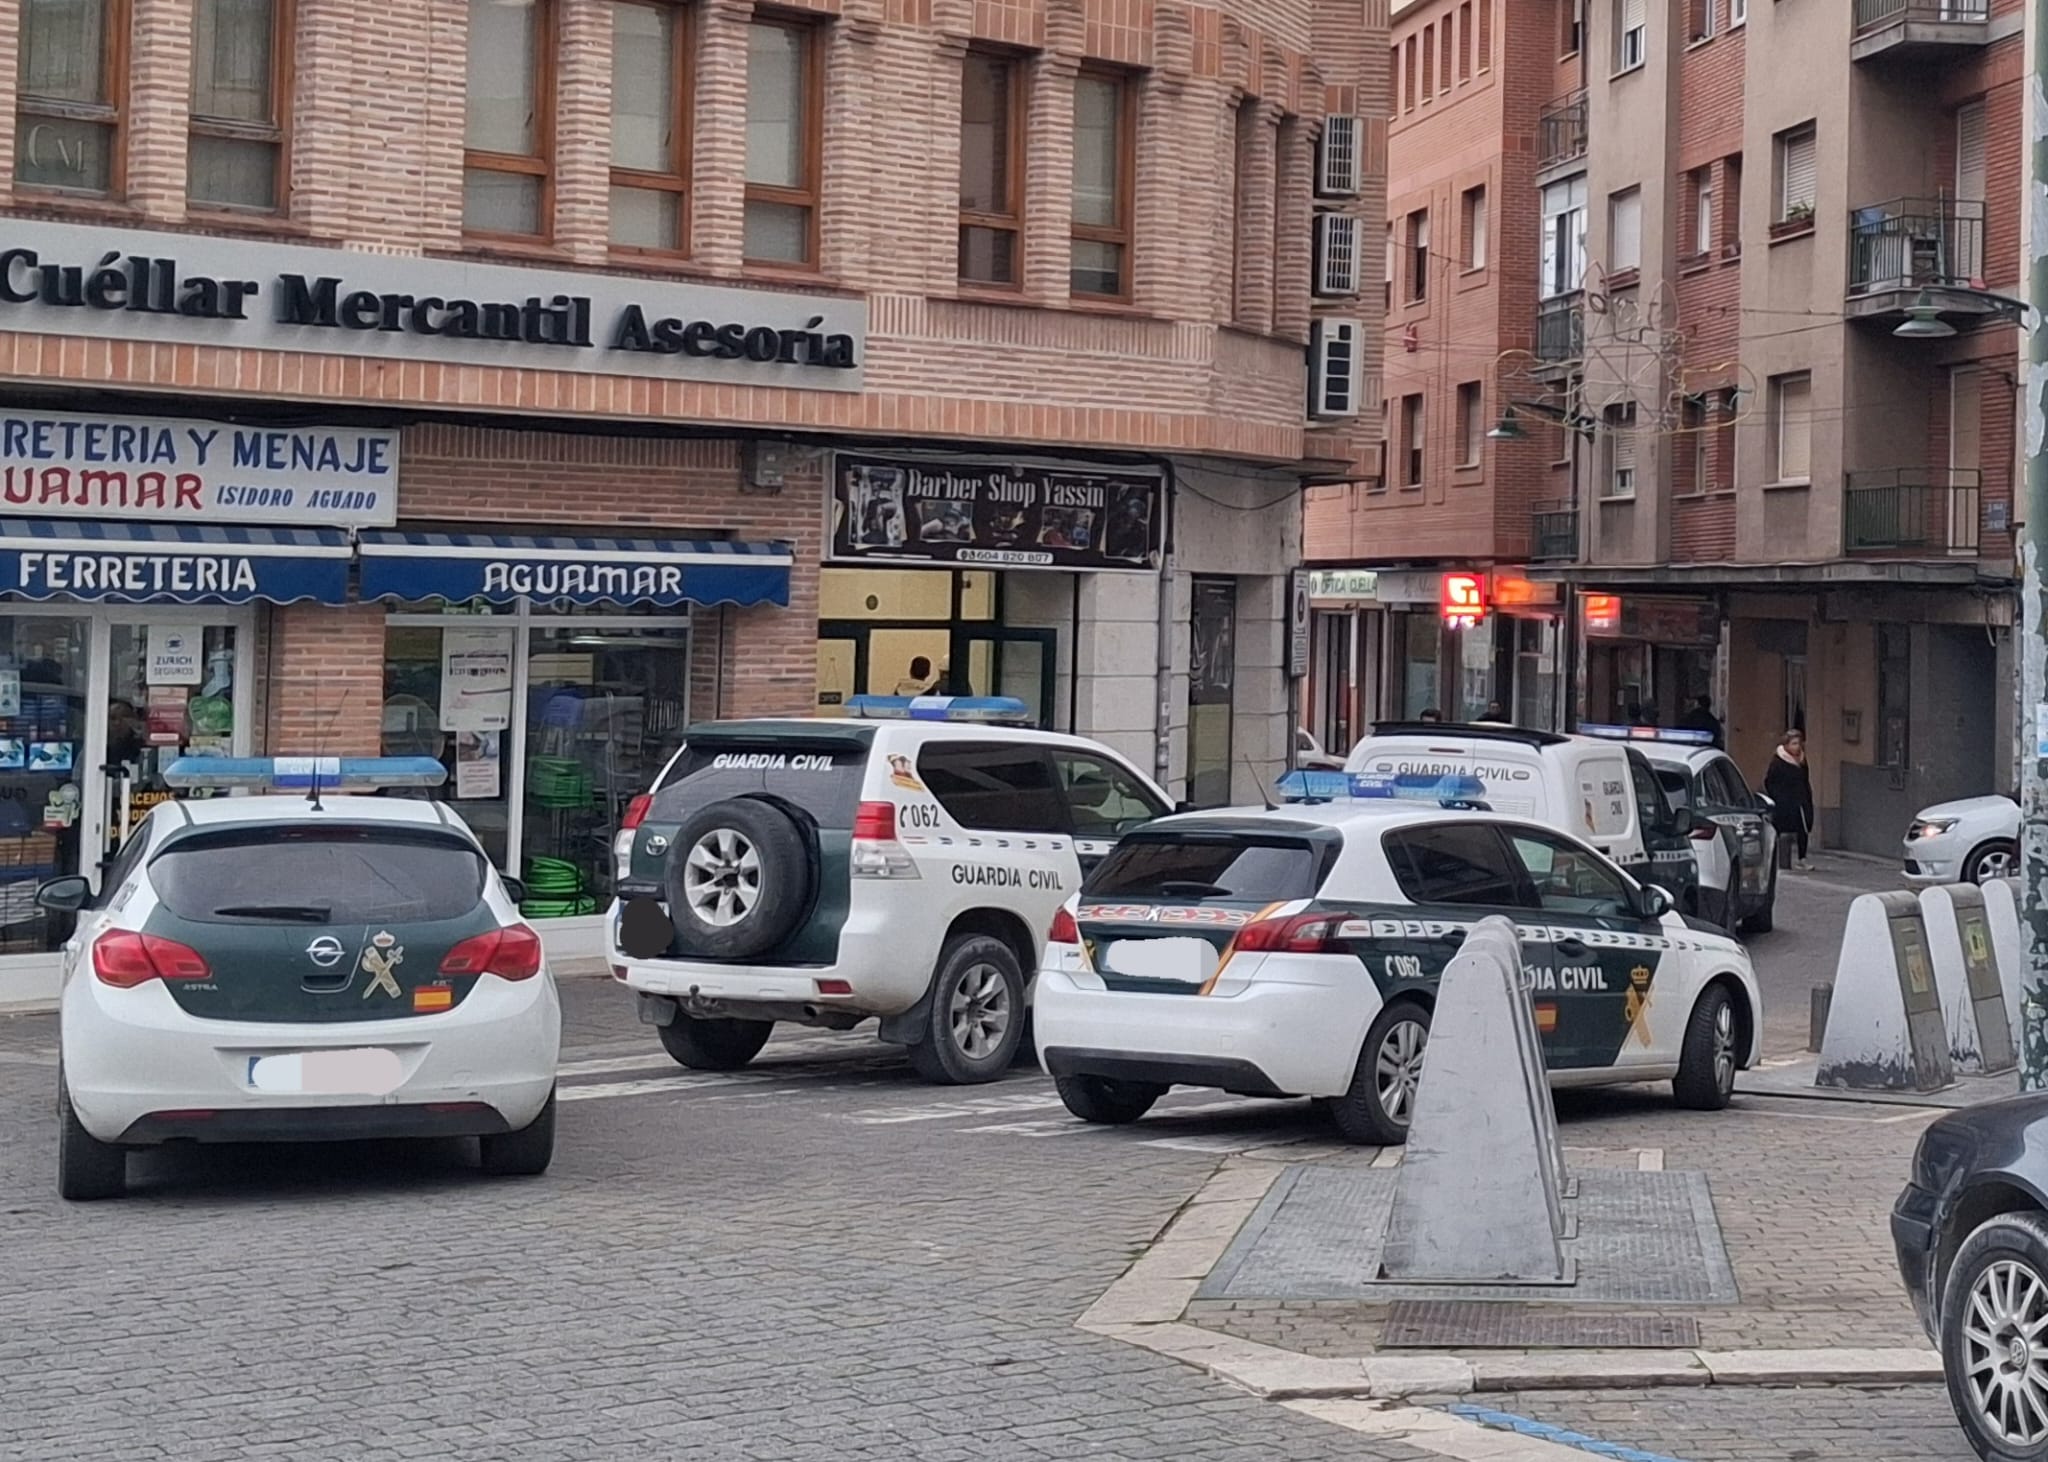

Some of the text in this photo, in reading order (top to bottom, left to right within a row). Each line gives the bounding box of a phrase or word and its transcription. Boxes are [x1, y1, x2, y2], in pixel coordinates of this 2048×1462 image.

[0, 248, 858, 369] Cuéllar Mercantil Asesoría
[3, 419, 391, 474] RETERIA Y MENAJE
[216, 485, 293, 507] ISIDORO
[307, 489, 377, 511] AGUADO
[907, 469, 1104, 508] Barber Shop Yassin
[19, 553, 257, 592] FERRETERIA
[482, 561, 682, 595] AGUAMAR
[156, 655, 193, 665] ZURICH
[713, 754, 833, 772] GUARDIA CIVIL
[1398, 762, 1513, 781] GUARDIA CIVIL
[911, 803, 940, 828] 062
[951, 864, 1063, 890] GUARDIA CIVIL
[1398, 955, 1423, 978] 062
[1560, 967, 1608, 990] CIVIL
